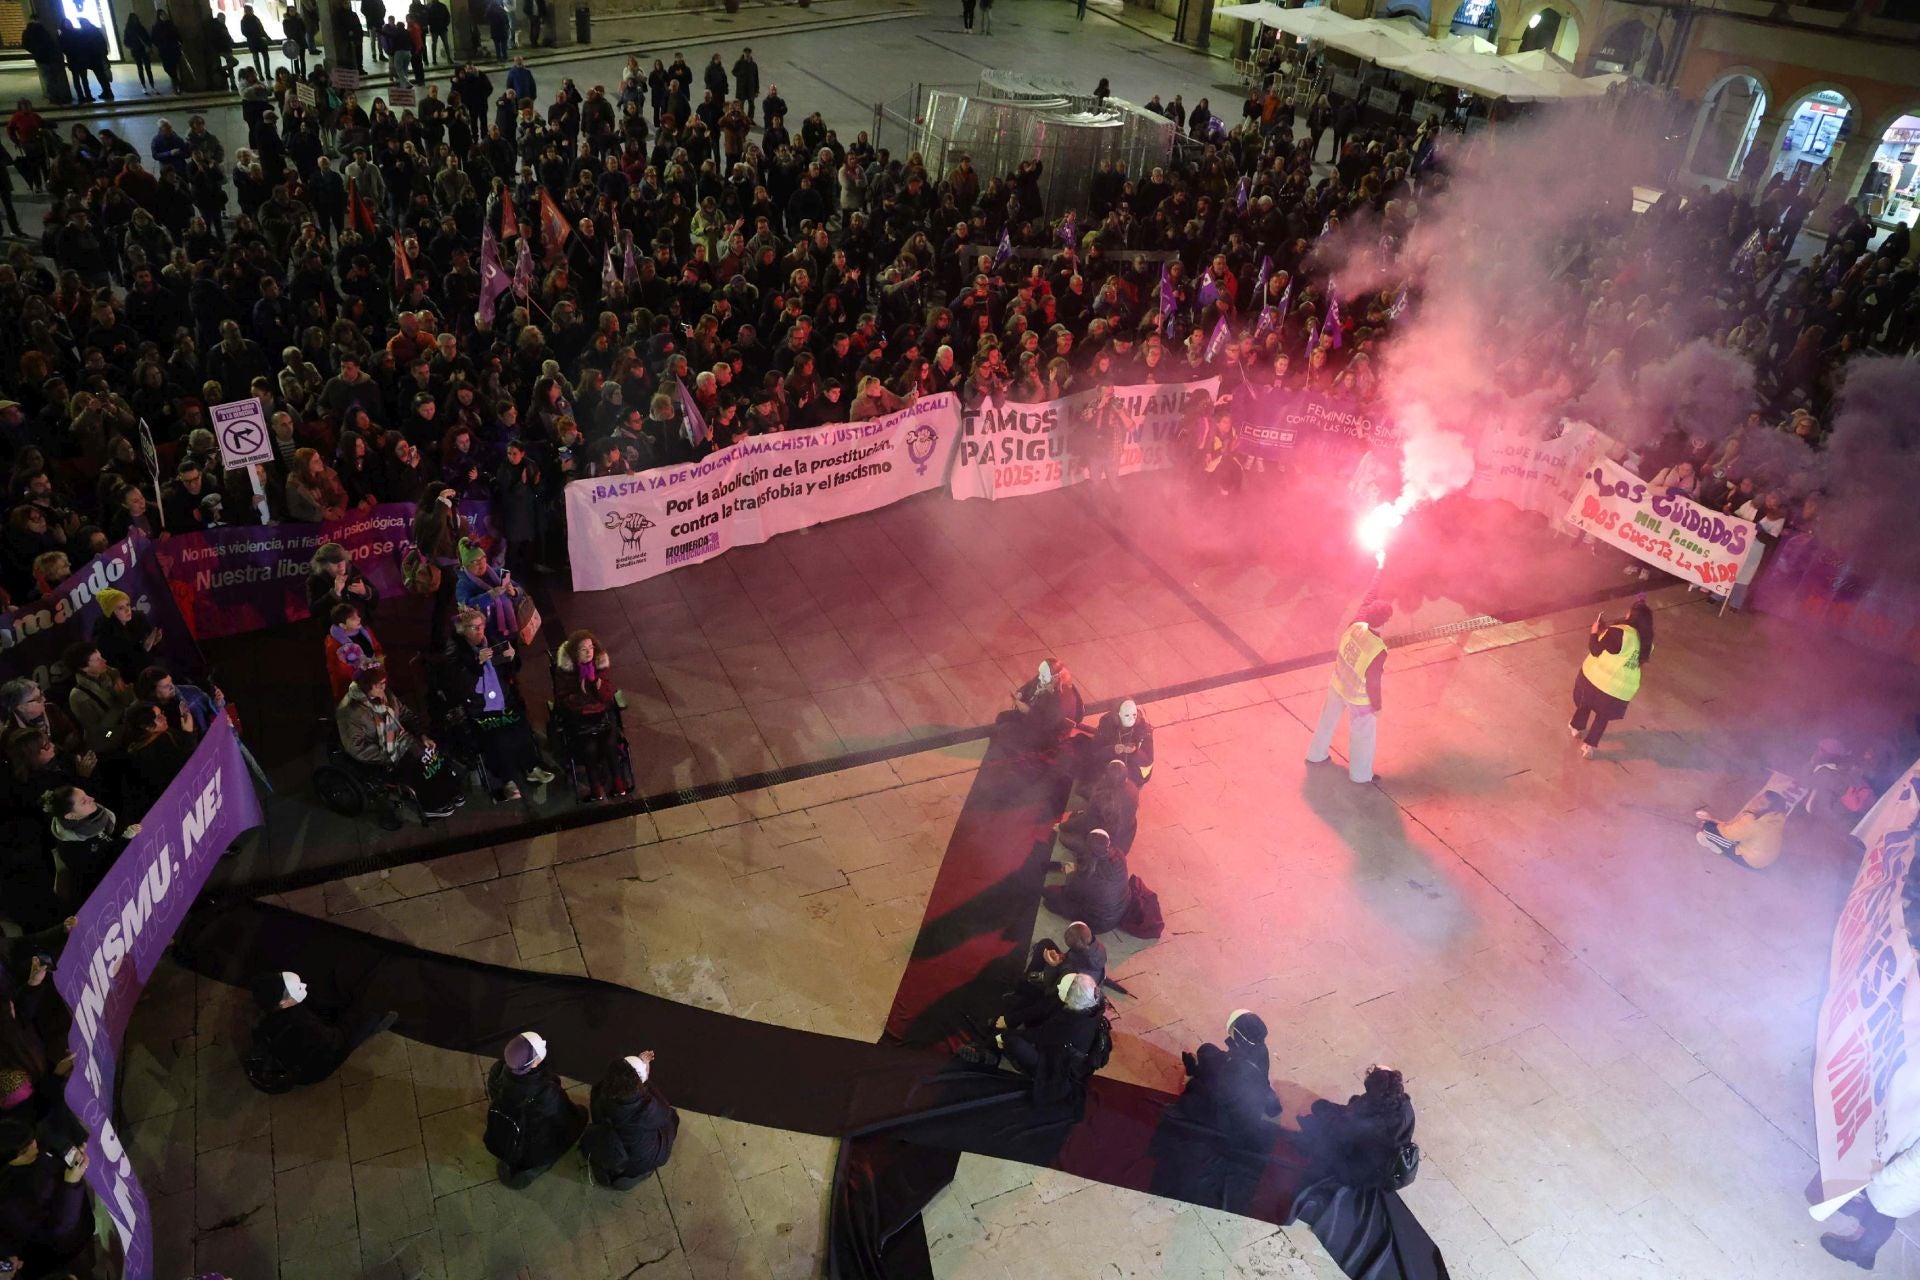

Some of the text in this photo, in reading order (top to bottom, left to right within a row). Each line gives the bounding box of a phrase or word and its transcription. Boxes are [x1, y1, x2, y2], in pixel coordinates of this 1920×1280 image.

[963, 408, 1058, 436] TAMOS
[1243, 425, 1279, 441] CCOO
[1286, 414, 1321, 428] CONTRA
[1323, 423, 1340, 434] LAS
[1306, 402, 1372, 431] FEMINISMO
[592, 481, 646, 504] ¡BASTA
[649, 476, 667, 490] YA
[669, 471, 687, 485] DE
[690, 444, 750, 479] VIOLENCIA
[749, 435, 819, 455] MACHISTA
[820, 432, 830, 446] Y
[832, 423, 883, 446] JUSTICIA
[995, 464, 1041, 489] 2025:
[1045, 461, 1063, 482] 75
[665, 497, 694, 517] Por
[697, 490, 710, 507] la
[712, 466, 769, 500] abolición
[772, 463, 793, 479] de
[795, 459, 808, 474] la
[670, 461, 893, 538] contra la transfobia y el fascismo
[182, 548, 199, 563] No
[201, 542, 226, 560] más
[228, 537, 284, 554] violencia,
[287, 537, 299, 549] ni
[333, 528, 343, 540] ni
[344, 516, 406, 539] psicológica,
[666, 535, 710, 559] IZQUIERDA
[196, 566, 272, 592] Nuestra
[277, 559, 312, 578] libe
[350, 544, 370, 561] no
[373, 540, 394, 556] se
[181, 768, 224, 860] NE!
